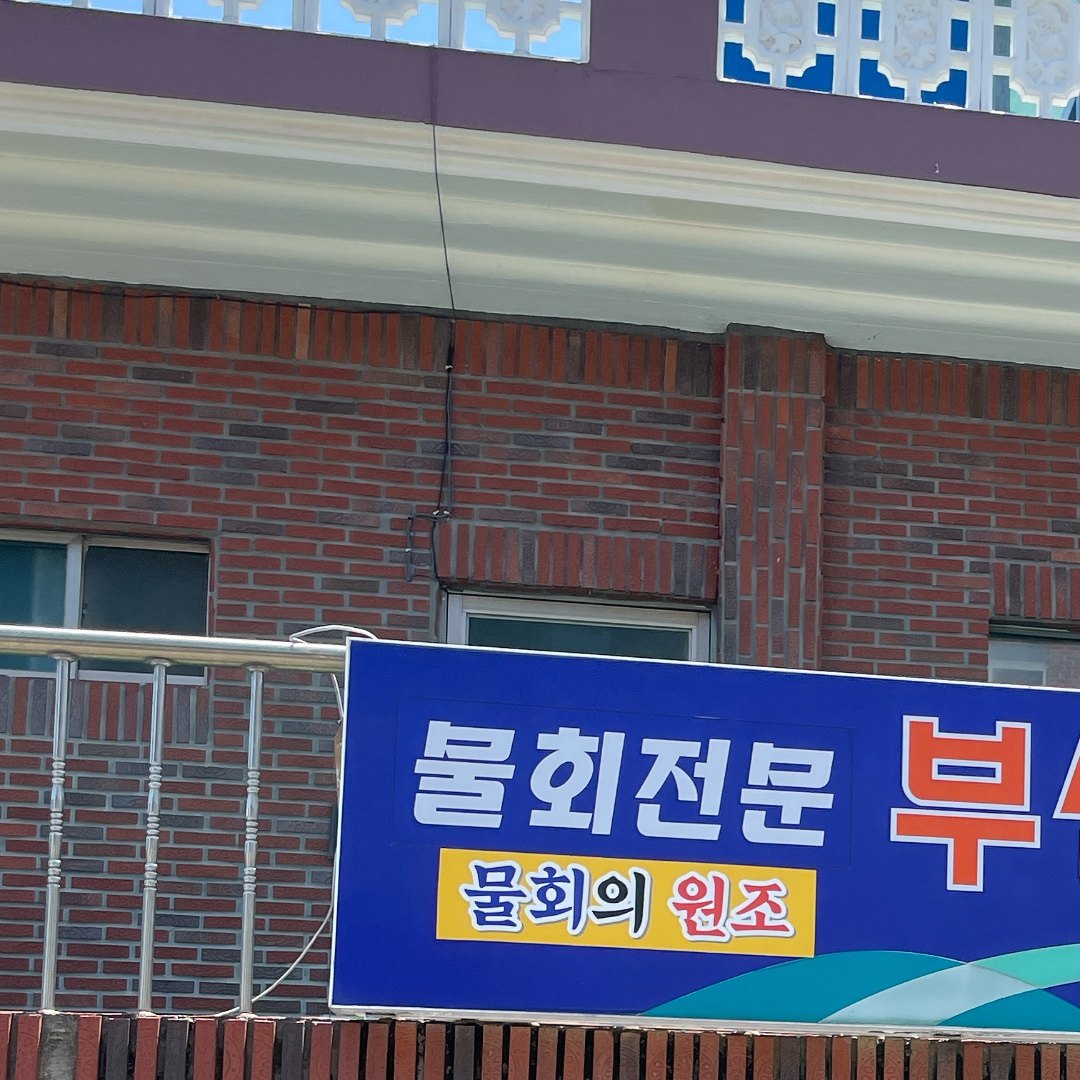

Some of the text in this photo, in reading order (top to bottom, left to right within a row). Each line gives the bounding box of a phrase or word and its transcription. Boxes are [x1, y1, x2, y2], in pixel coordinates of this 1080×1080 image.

[413, 719, 835, 847] 물회전문
[460, 859, 797, 943] 물회의 원조
